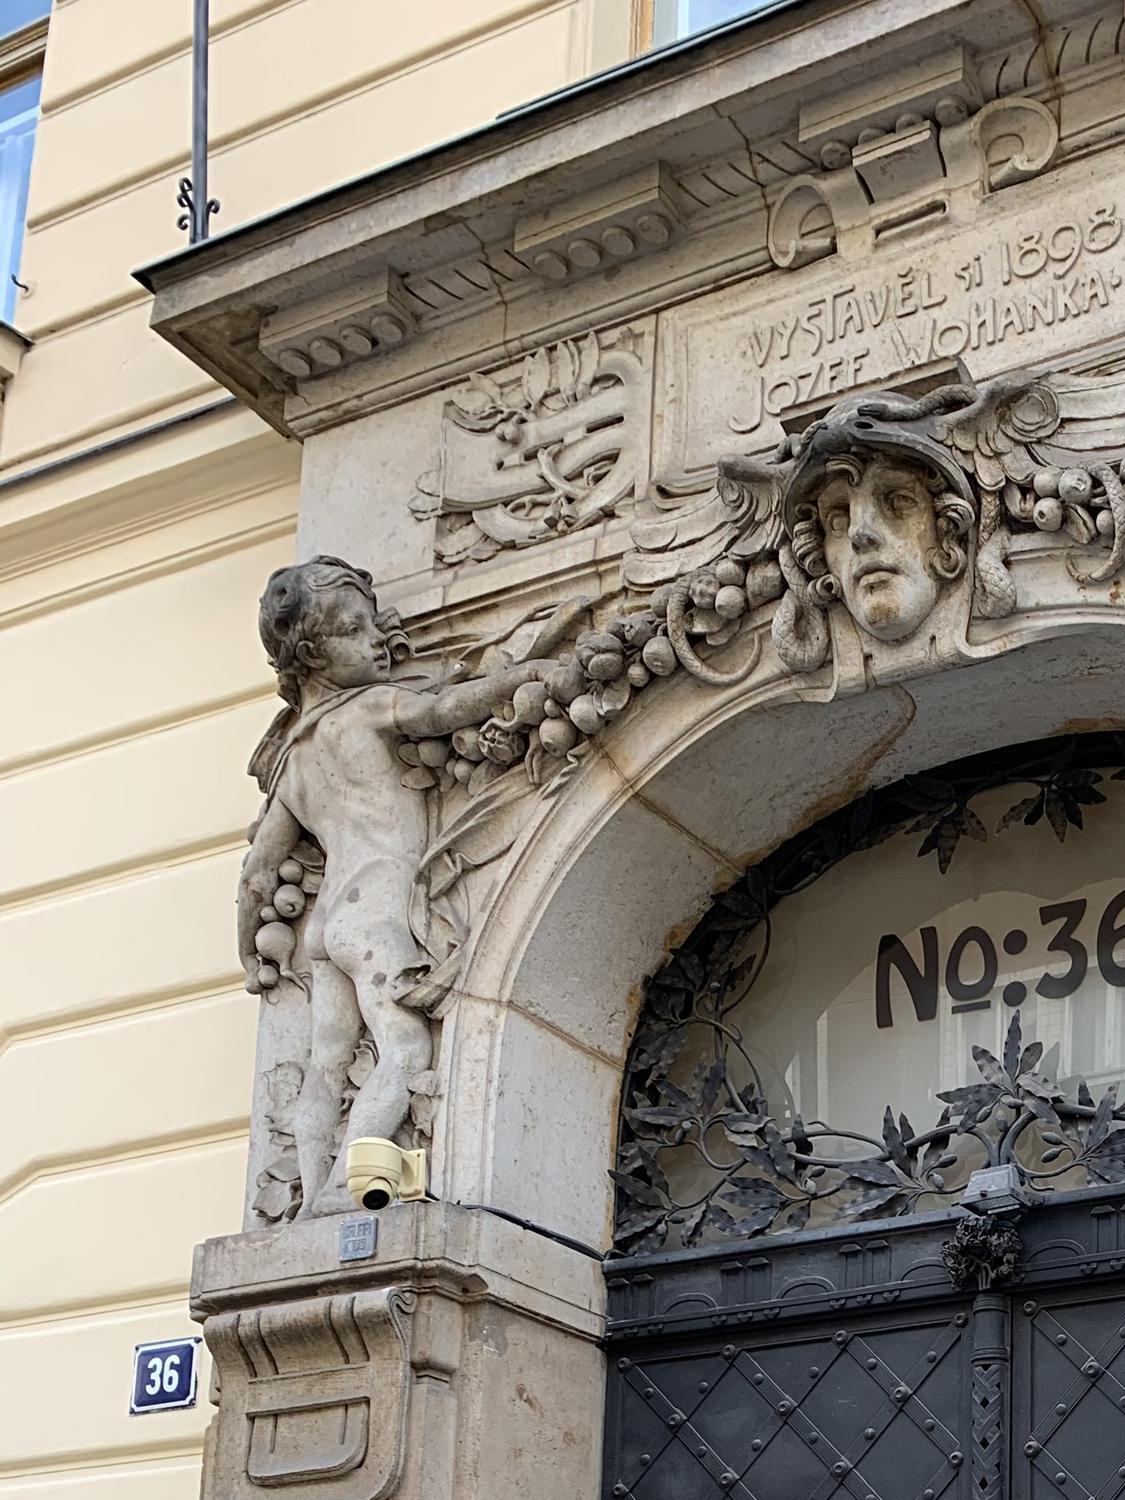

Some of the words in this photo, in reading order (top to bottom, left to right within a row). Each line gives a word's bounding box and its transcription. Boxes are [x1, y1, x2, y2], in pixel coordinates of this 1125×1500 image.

[749, 266, 948, 369] VYSTAVĚL
[1002, 202, 1123, 286] 1898
[145, 1354, 181, 1397] 36
